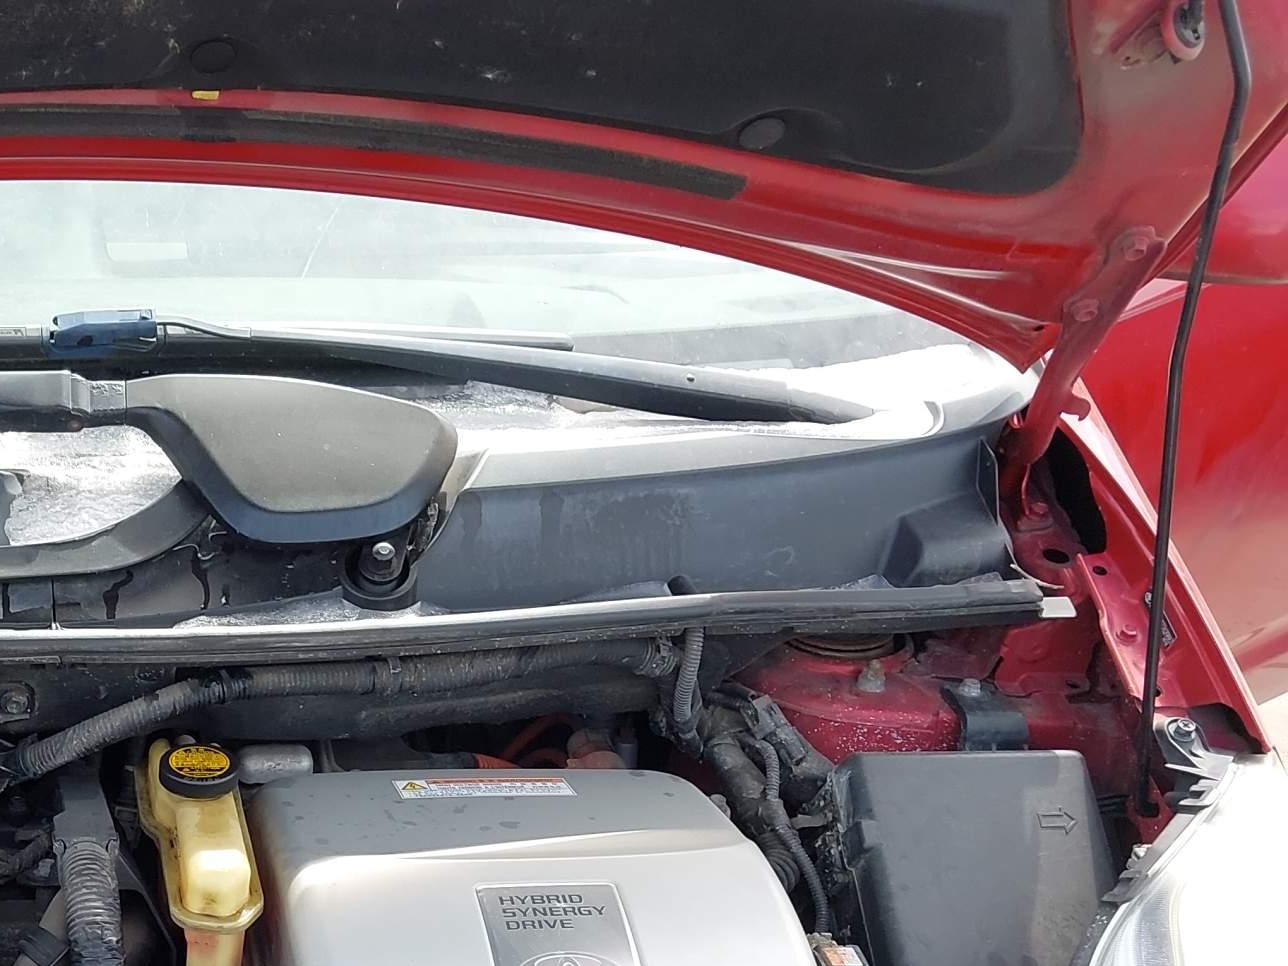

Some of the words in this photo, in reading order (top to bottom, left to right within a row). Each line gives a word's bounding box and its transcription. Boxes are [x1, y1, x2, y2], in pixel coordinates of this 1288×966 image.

[498, 894, 583, 905] HYBRID
[502, 905, 606, 918] SYNERGY
[505, 918, 575, 930] DRIVE
